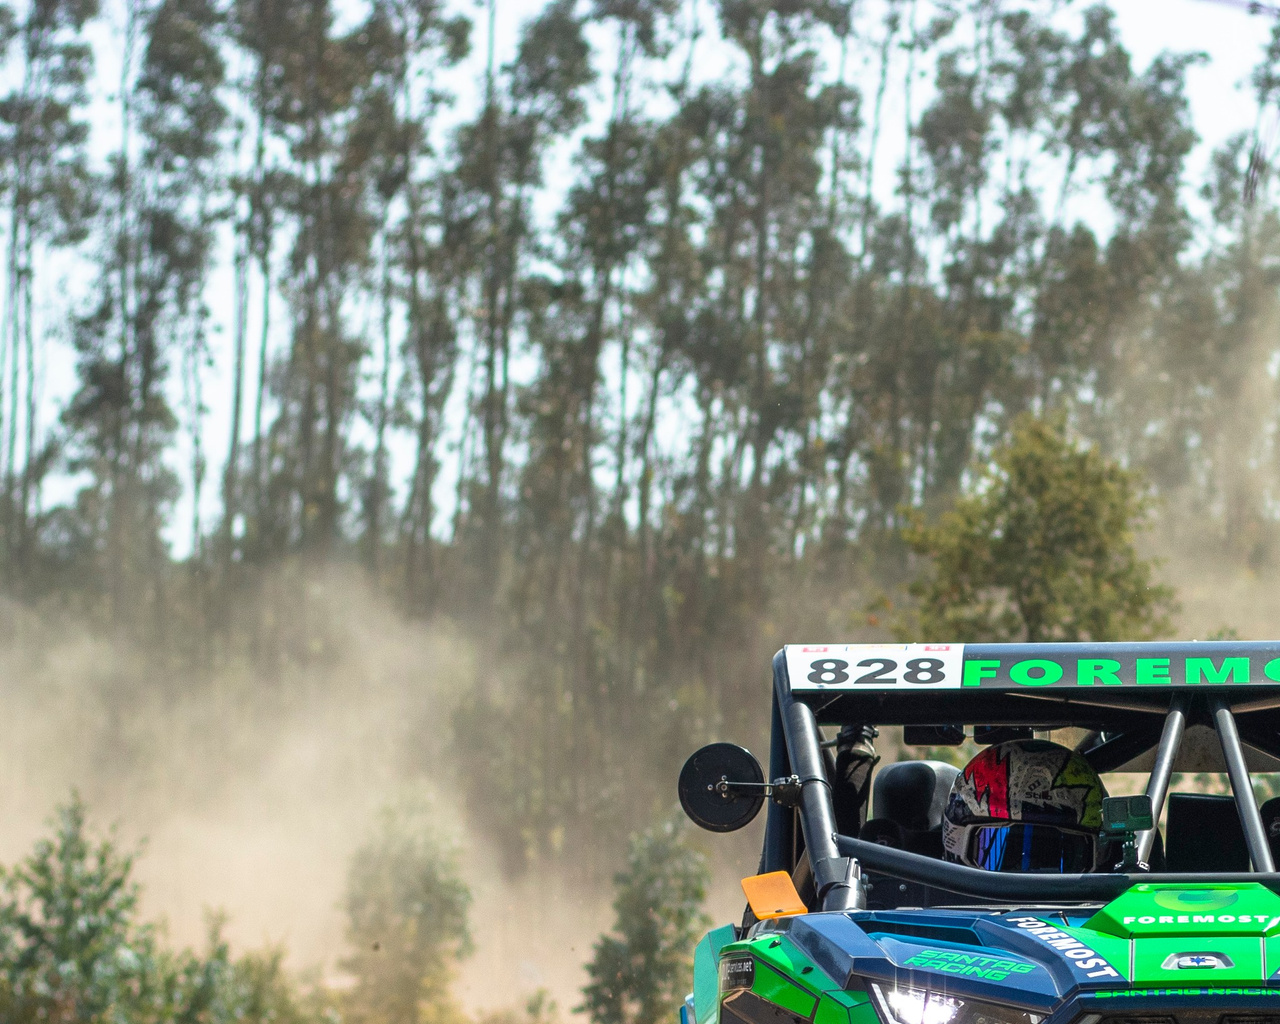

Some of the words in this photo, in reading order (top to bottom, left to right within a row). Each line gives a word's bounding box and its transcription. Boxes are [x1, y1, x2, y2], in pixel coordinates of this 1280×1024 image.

[807, 657, 946, 685] 828
[1123, 915, 1269, 925] FOREMOST
[1006, 916, 1119, 979] FOREMOST
[902, 956, 1011, 981] RACING
[916, 949, 1037, 974] SANTAG
[1095, 988, 1201, 999] SANTAG
